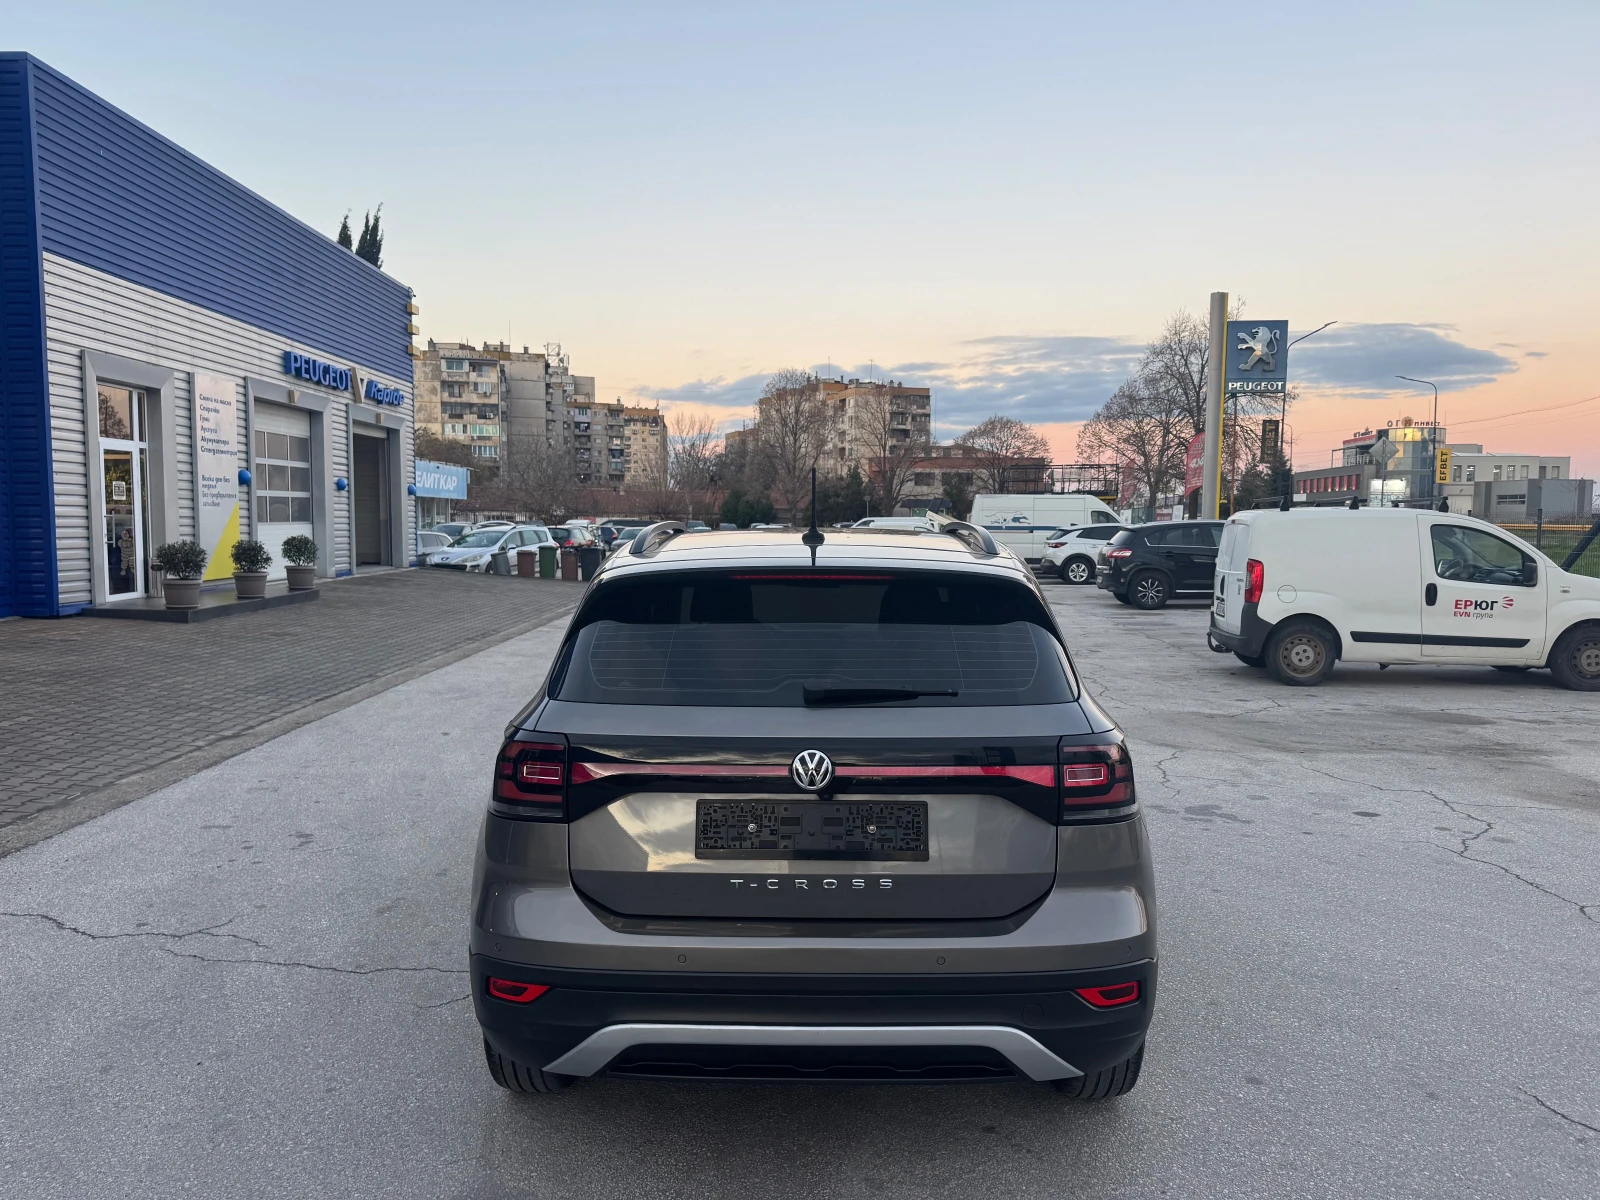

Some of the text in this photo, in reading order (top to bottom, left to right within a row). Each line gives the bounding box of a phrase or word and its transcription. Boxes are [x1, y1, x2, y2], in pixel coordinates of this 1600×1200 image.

[285, 351, 405, 406] PEUGEOT Rapide
[1228, 381, 1284, 391] PEUGEOT
[1440, 451, 1448, 481] EFBET
[1454, 599, 1498, 611] ЕРЮГ
[730, 879, 893, 889] T-CROSS
